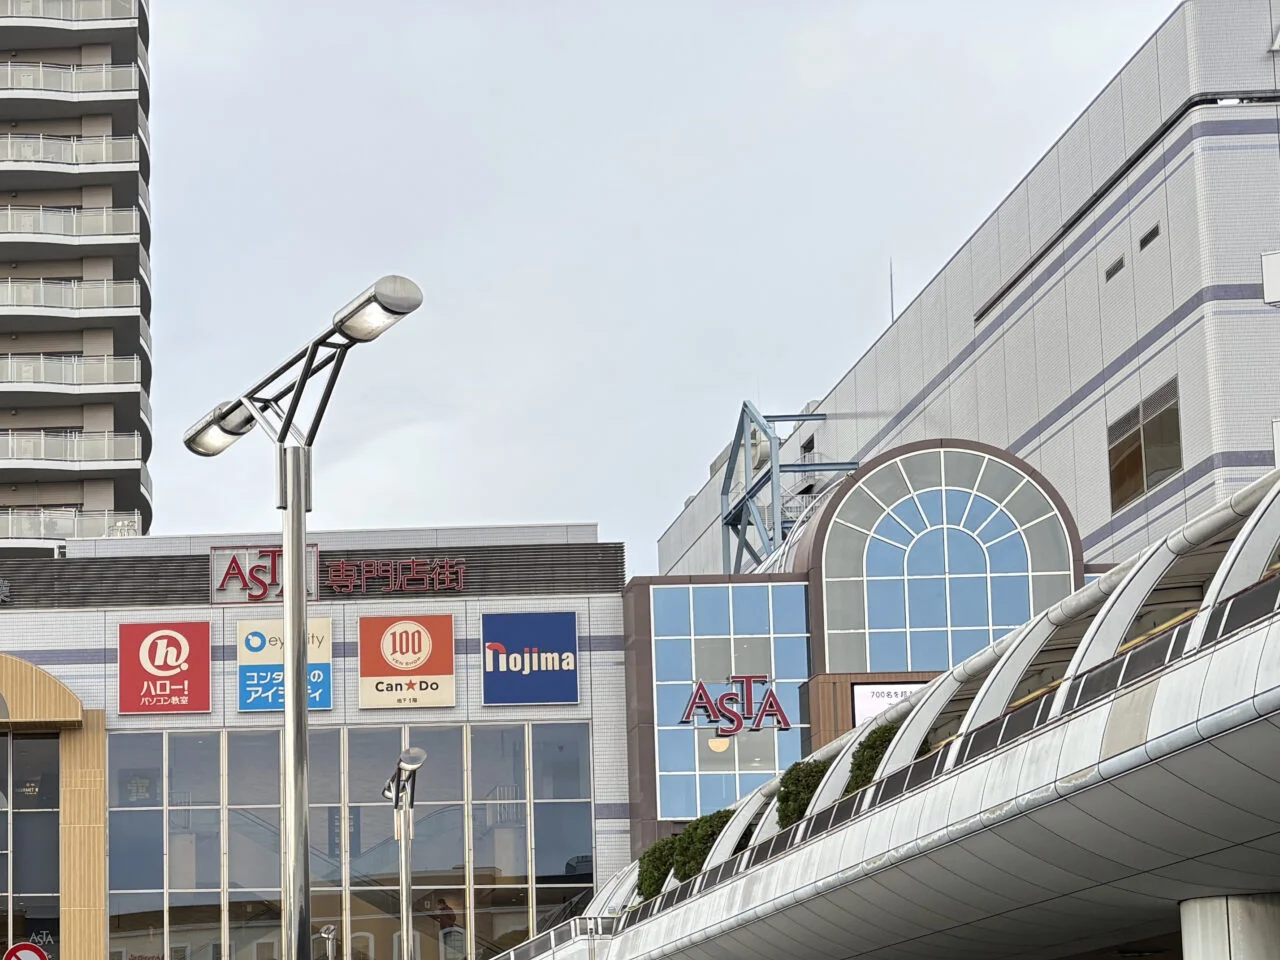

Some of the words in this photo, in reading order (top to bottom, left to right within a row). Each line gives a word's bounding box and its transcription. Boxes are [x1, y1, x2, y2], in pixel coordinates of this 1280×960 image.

[217, 550, 311, 600] AST
[325, 557, 466, 593] 専門店街
[268, 634, 324, 650] eyity
[390, 630, 422, 656] 100
[485, 642, 575, 675] nojima
[246, 670, 323, 684] コンタの
[140, 680, 188, 696] ハロー!
[140, 696, 188, 706] パソコン教室
[682, 674, 791, 735] ASTA
[29, 930, 54, 945] ASTA
